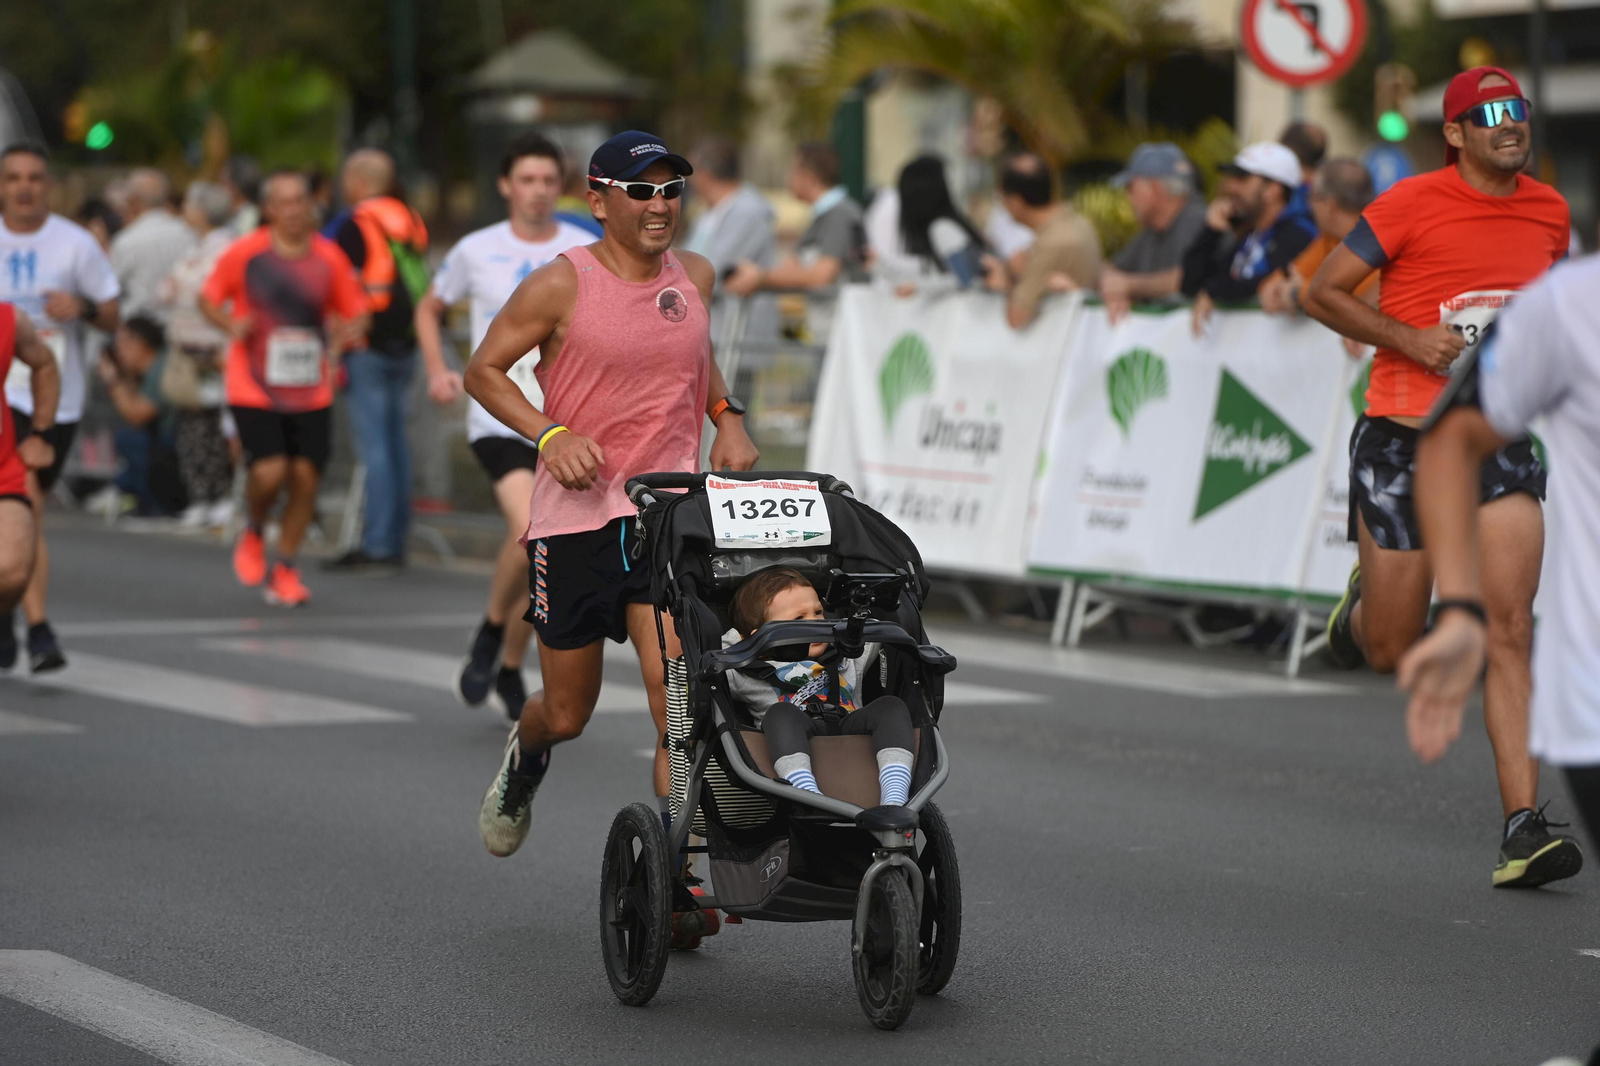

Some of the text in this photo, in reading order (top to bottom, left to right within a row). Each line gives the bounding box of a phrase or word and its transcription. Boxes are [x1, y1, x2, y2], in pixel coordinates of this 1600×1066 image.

[630, 144, 650, 152] MARINE
[919, 399, 1003, 465] Unicaja
[721, 498, 816, 520] 13267
[534, 539, 549, 624] BALANCE
